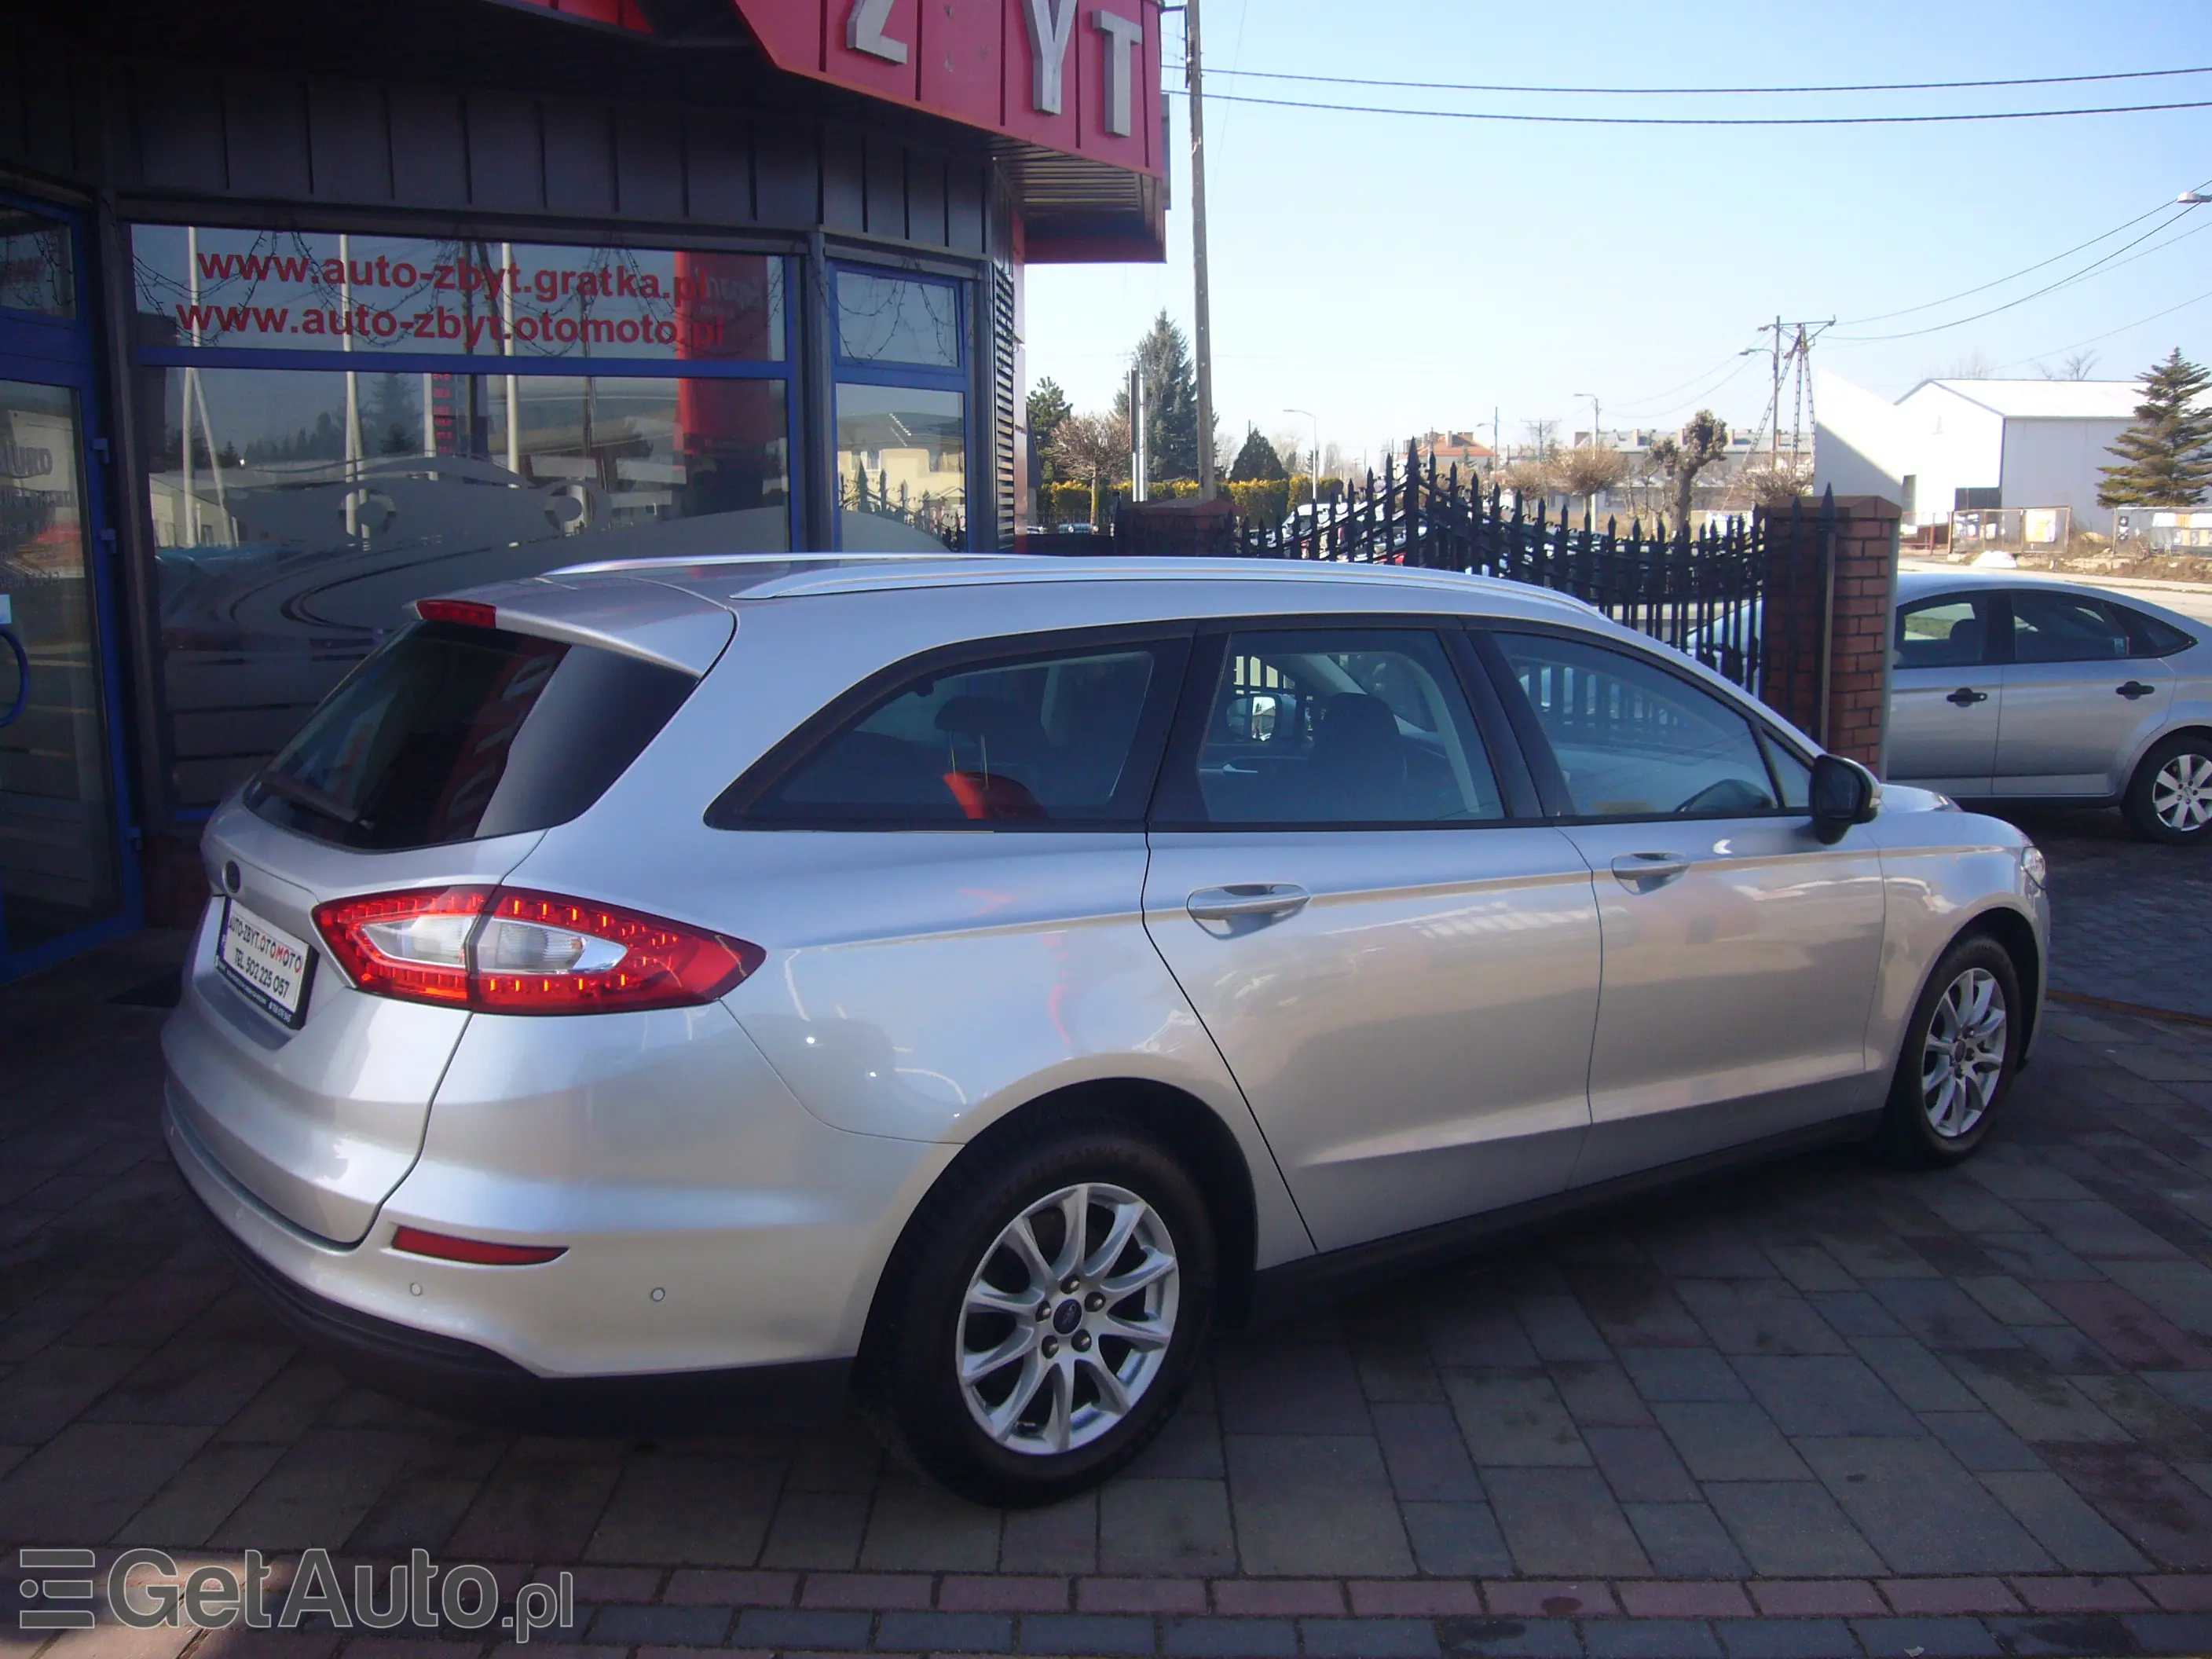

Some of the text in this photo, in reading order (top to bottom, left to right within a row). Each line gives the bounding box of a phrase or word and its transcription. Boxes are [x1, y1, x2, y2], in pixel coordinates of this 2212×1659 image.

[196, 252, 707, 307] www.auto-zbyt.gratka.pl
[245, 956, 260, 981] 502
[258, 966, 273, 989] 225
[273, 975, 291, 999] 057
